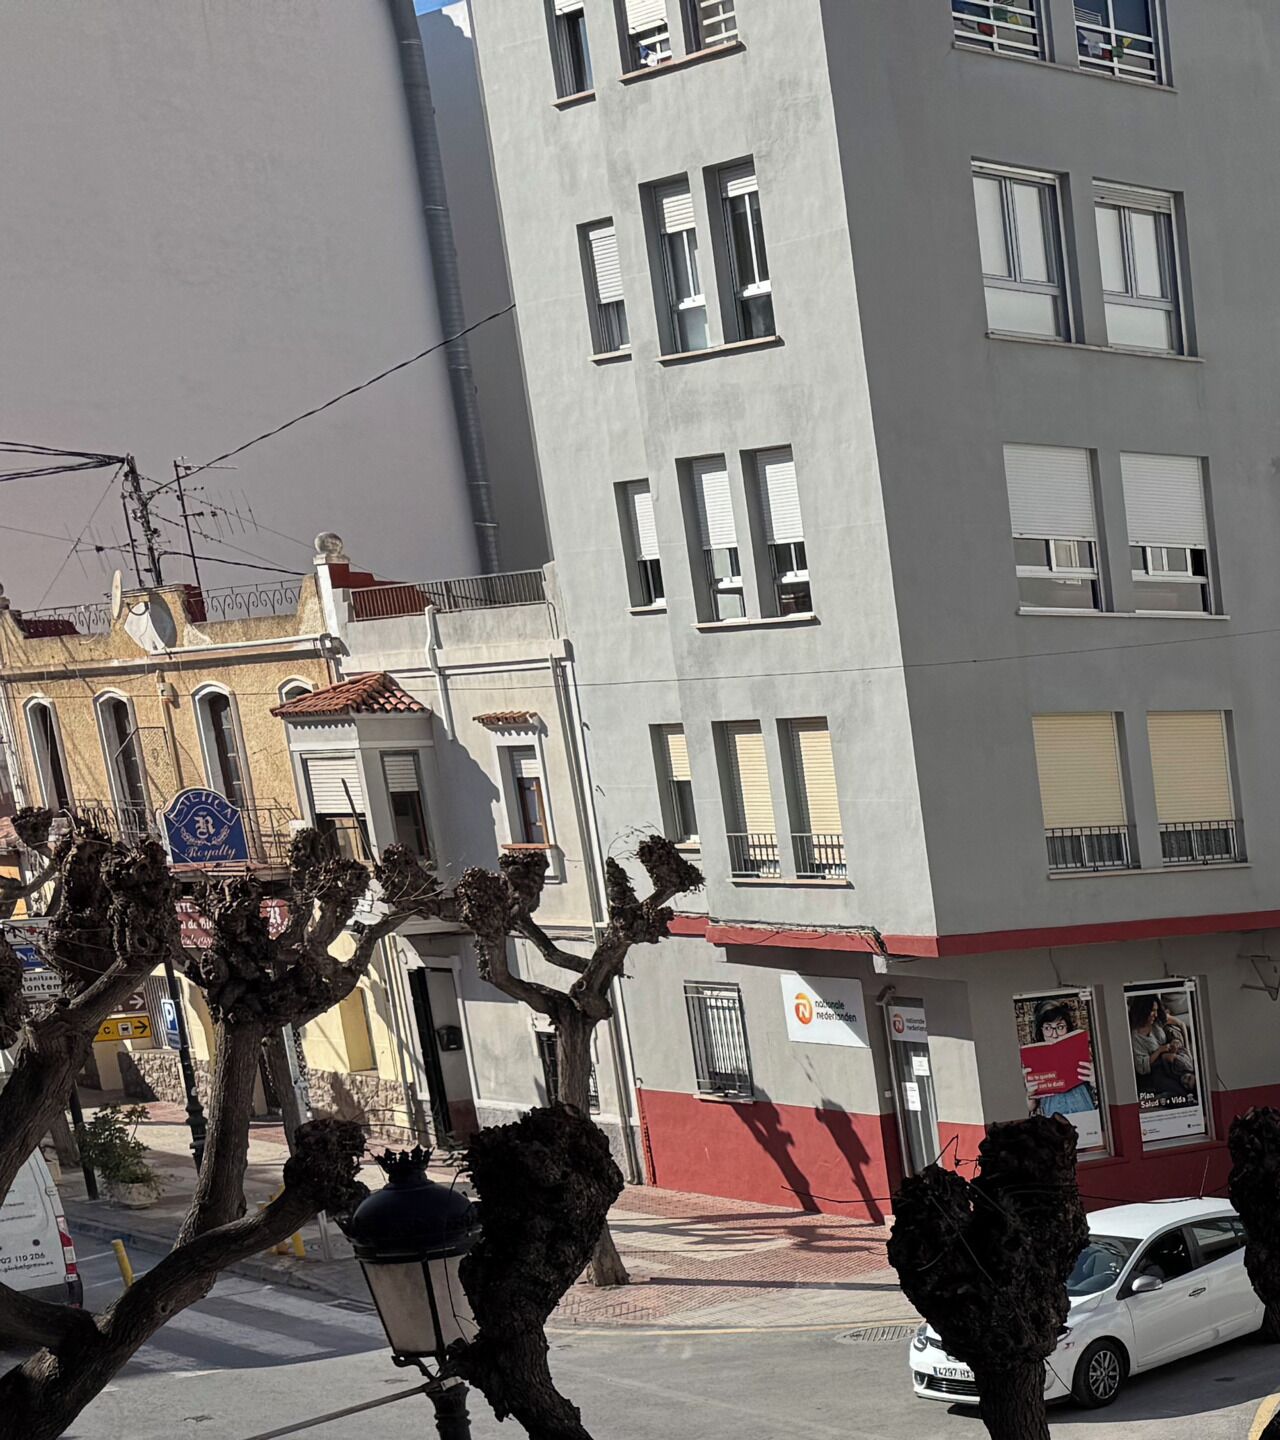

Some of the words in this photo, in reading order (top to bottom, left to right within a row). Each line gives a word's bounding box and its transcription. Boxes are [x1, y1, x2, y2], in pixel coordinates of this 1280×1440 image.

[185, 844, 236, 861] Royalty
[814, 1000, 845, 1010] nationale
[816, 1011, 857, 1022] nederlanden
[1140, 1092, 1155, 1100] Plan
[1141, 1100, 1159, 1108] Salud
[1171, 1096, 1186, 1104] Vida
